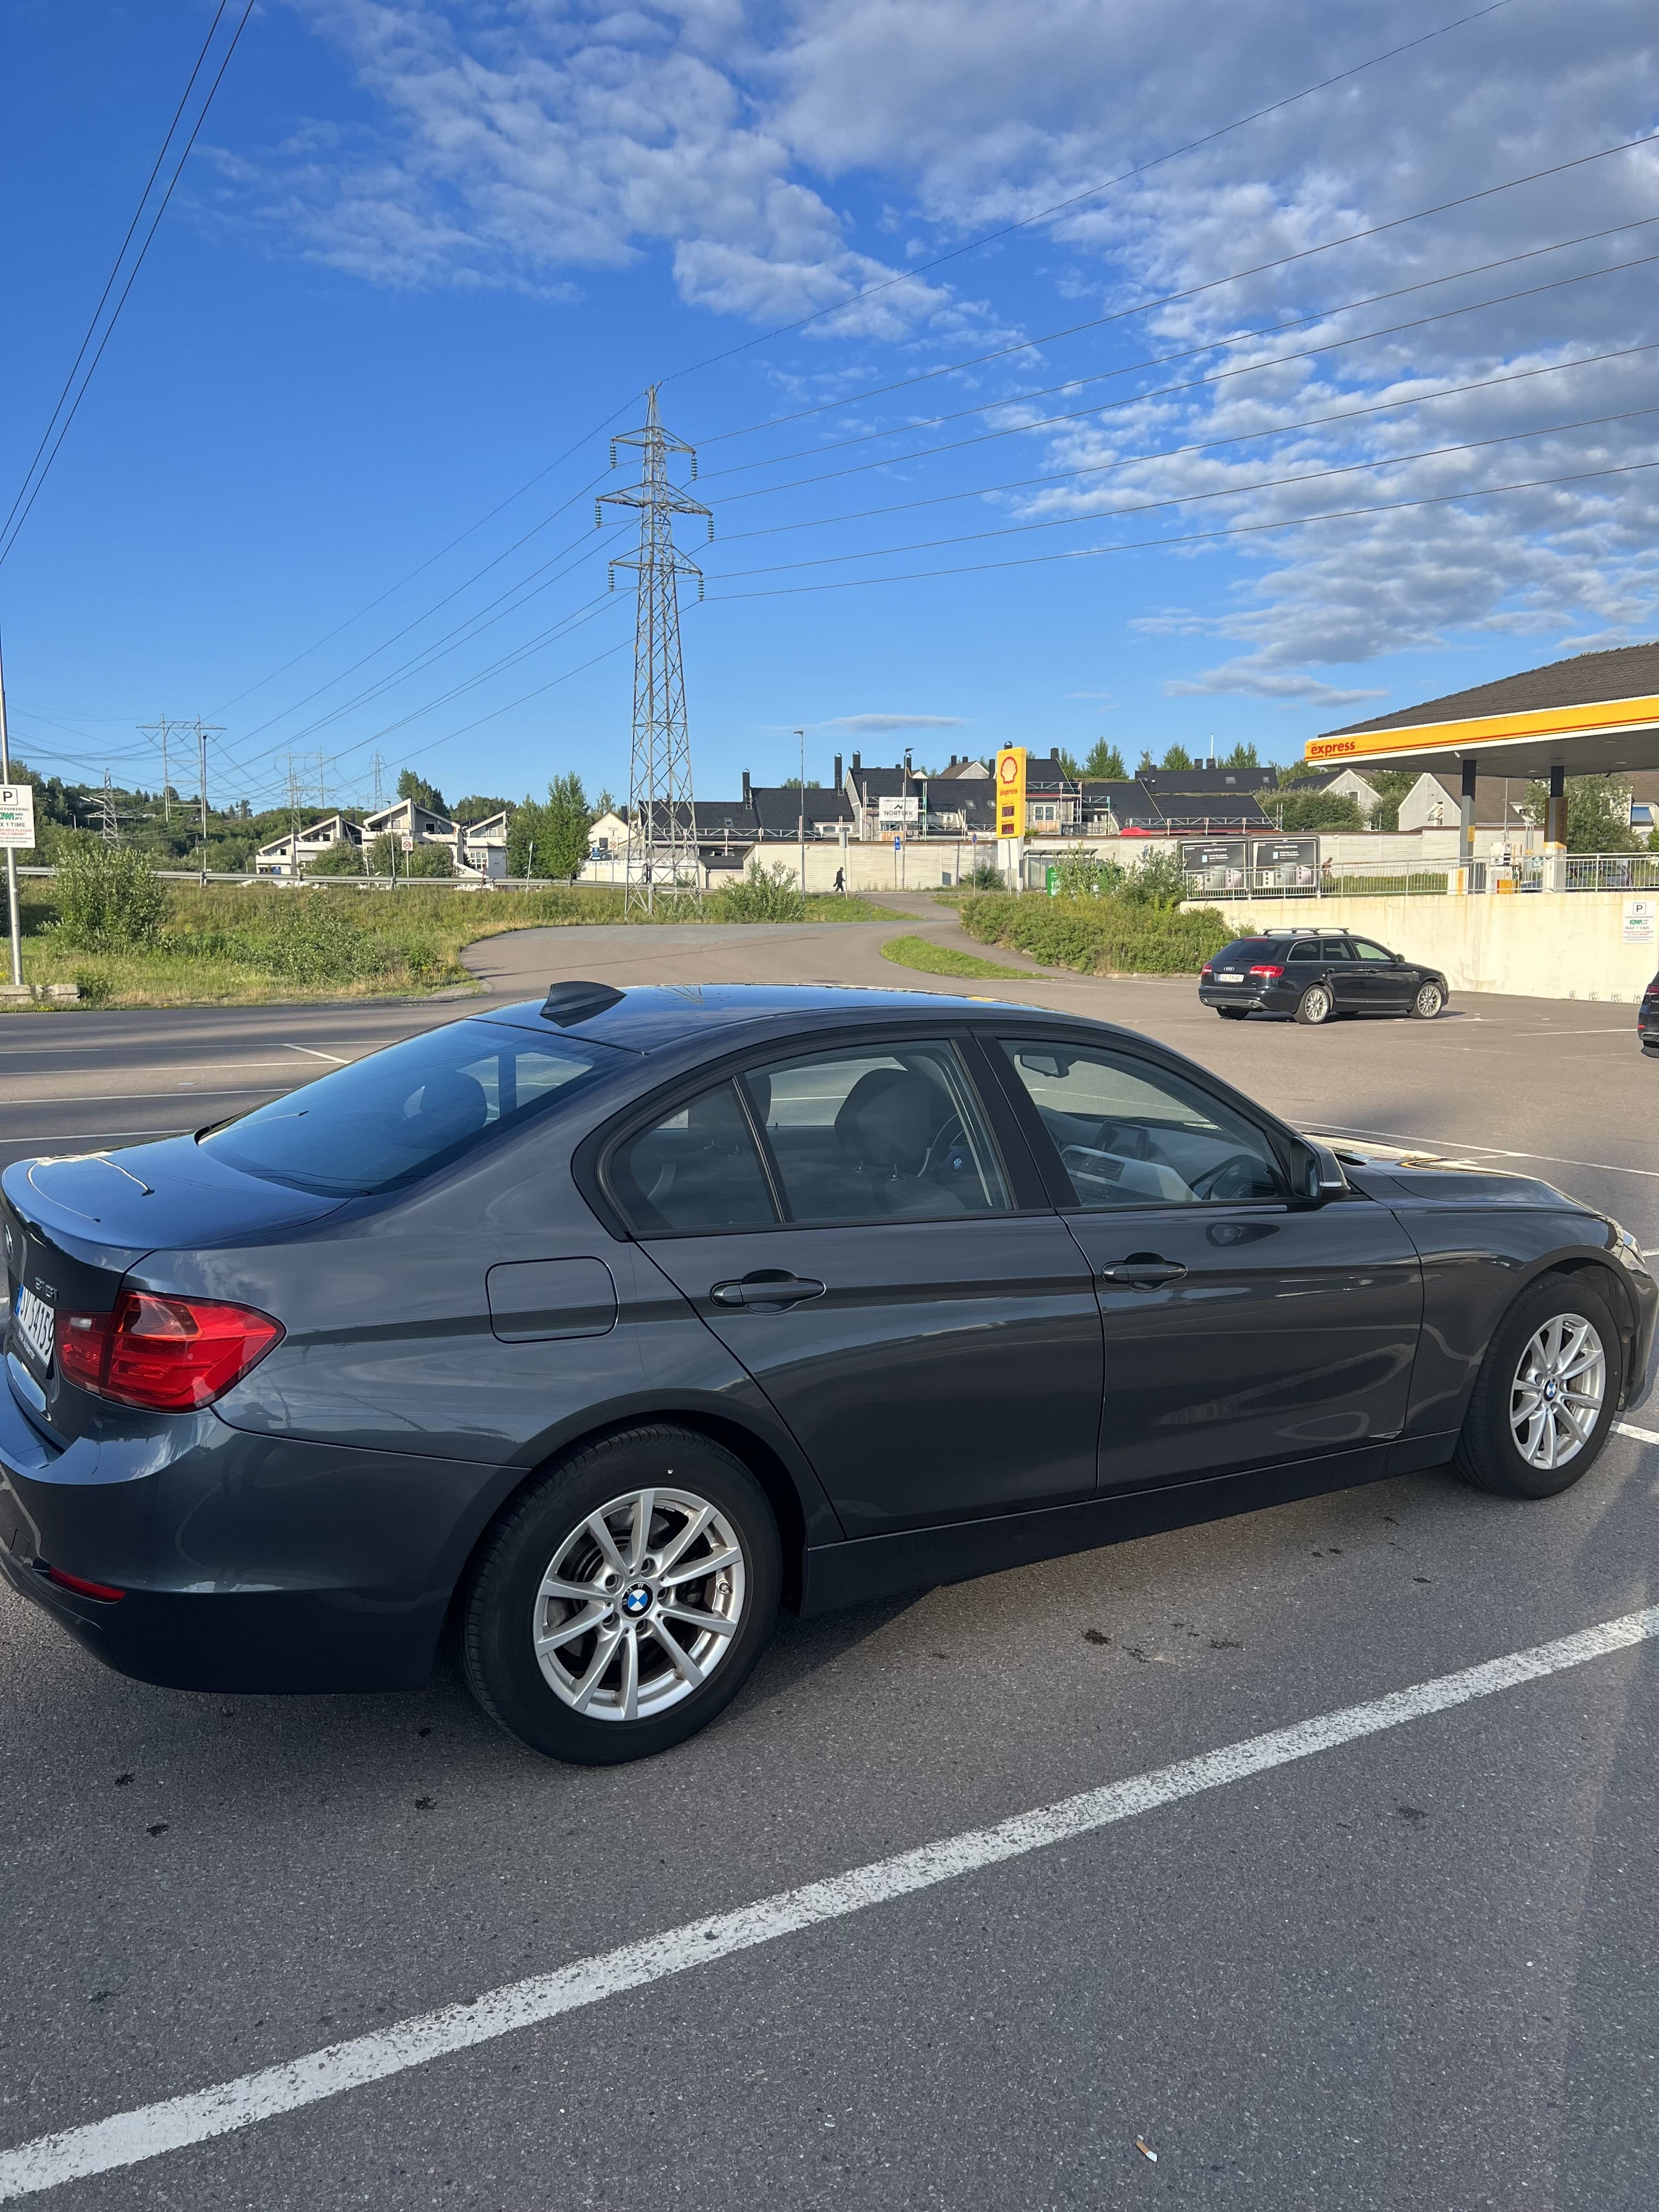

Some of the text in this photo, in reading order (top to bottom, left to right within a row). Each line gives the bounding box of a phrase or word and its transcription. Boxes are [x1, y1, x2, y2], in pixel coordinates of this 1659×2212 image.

[1311, 742, 1355, 757] express
[3, 791, 13, 802] P
[1000, 789, 1018, 797] express
[29, 1297, 54, 1356] 54159
[622, 1583, 644, 1606] BMW
